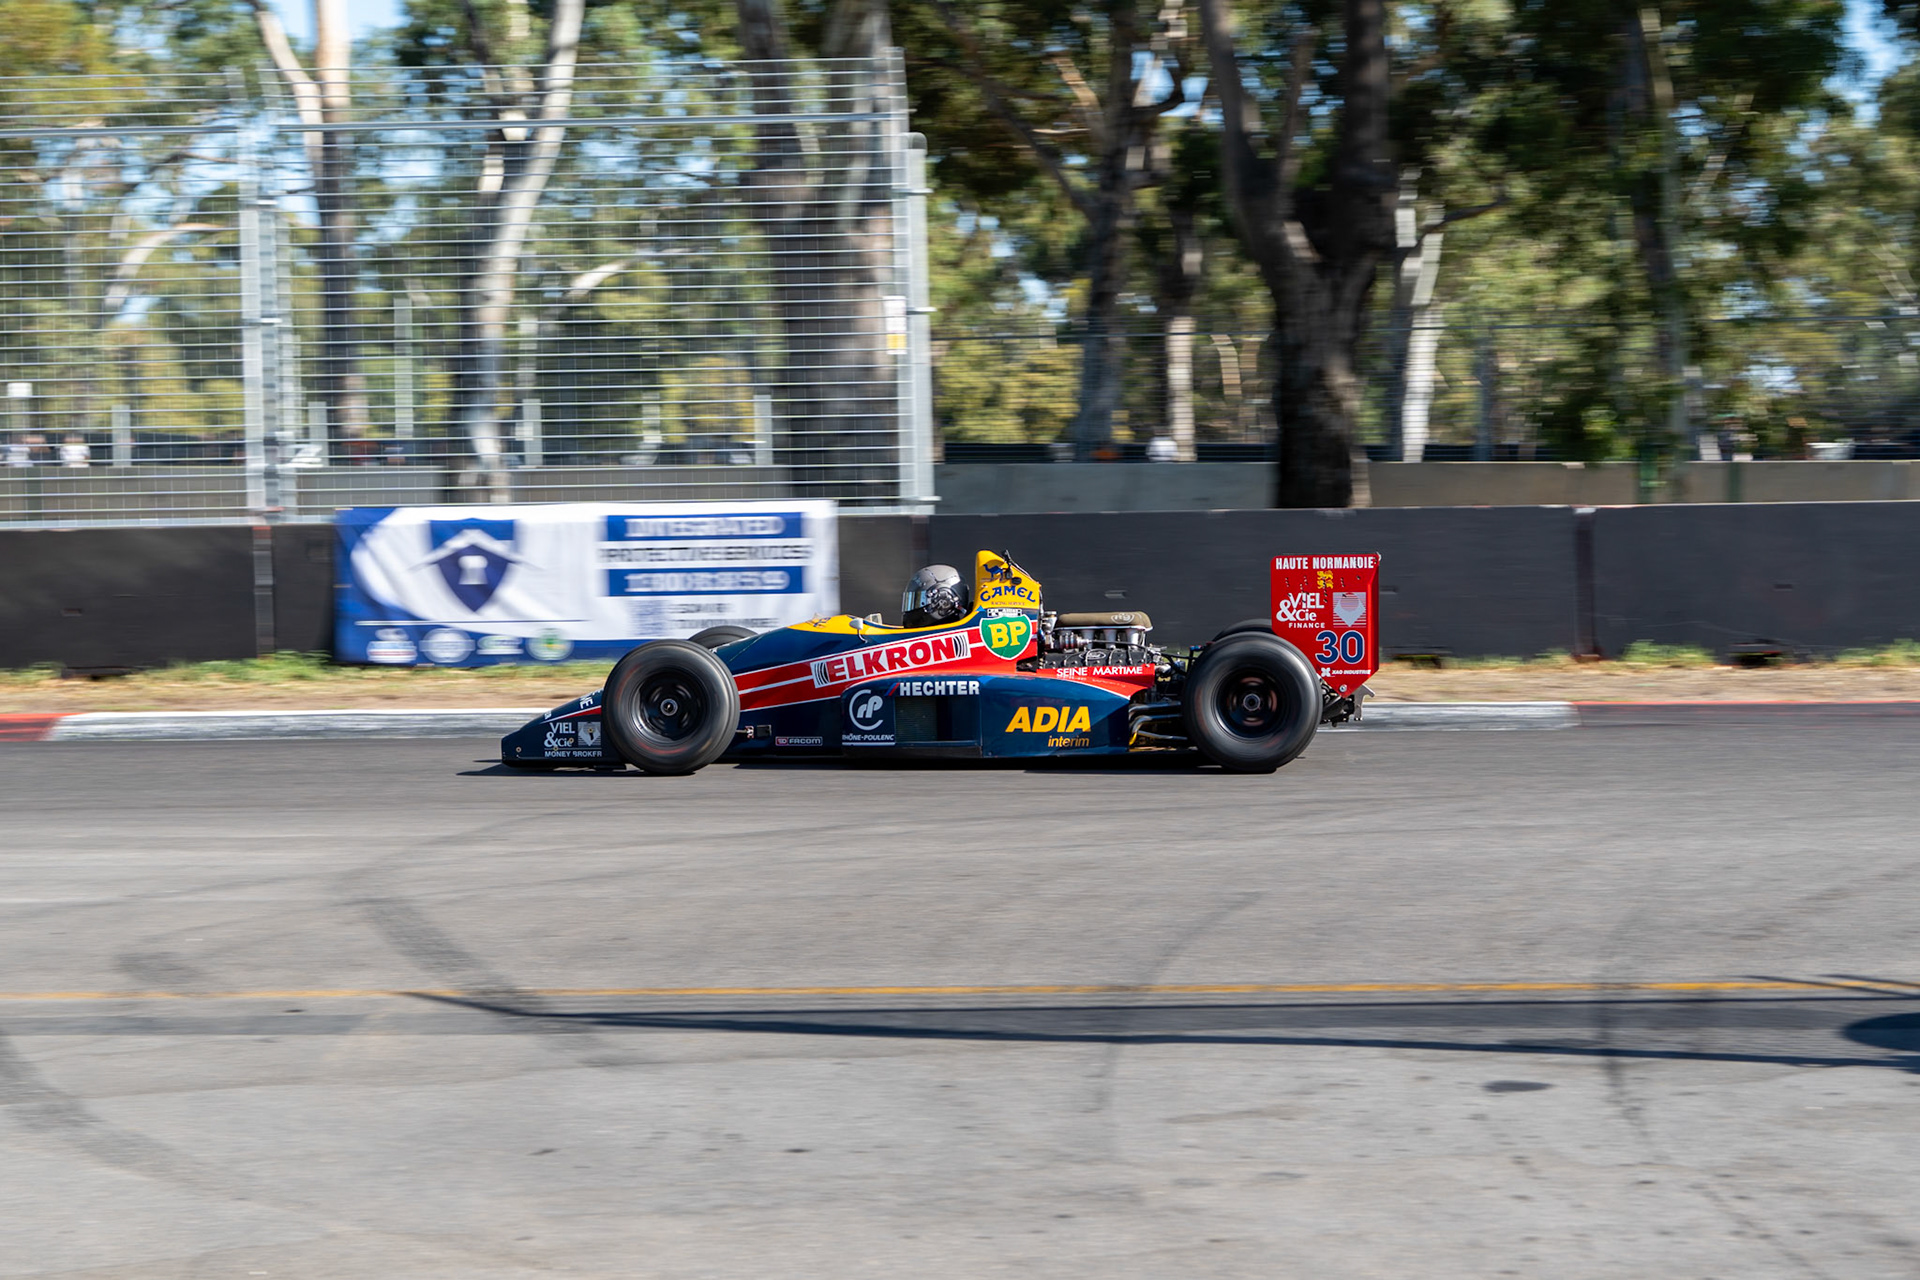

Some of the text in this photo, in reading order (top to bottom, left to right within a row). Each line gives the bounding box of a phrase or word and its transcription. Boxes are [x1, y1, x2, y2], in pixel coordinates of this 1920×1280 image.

[1276, 556, 1374, 570] HAUTE NORMANDIE
[980, 585, 1036, 602] CAMEL
[1287, 592, 1325, 609] VIEL
[988, 621, 1027, 648] BP
[1315, 630, 1365, 664] 30
[826, 637, 956, 683] ELKRON
[1056, 667, 1088, 676] SEINE
[900, 681, 980, 696] HECHTER
[1005, 706, 1091, 733] ADIA
[550, 722, 575, 734] VIEL
[1047, 735, 1090, 748] interim
[544, 750, 571, 758] MONEY
